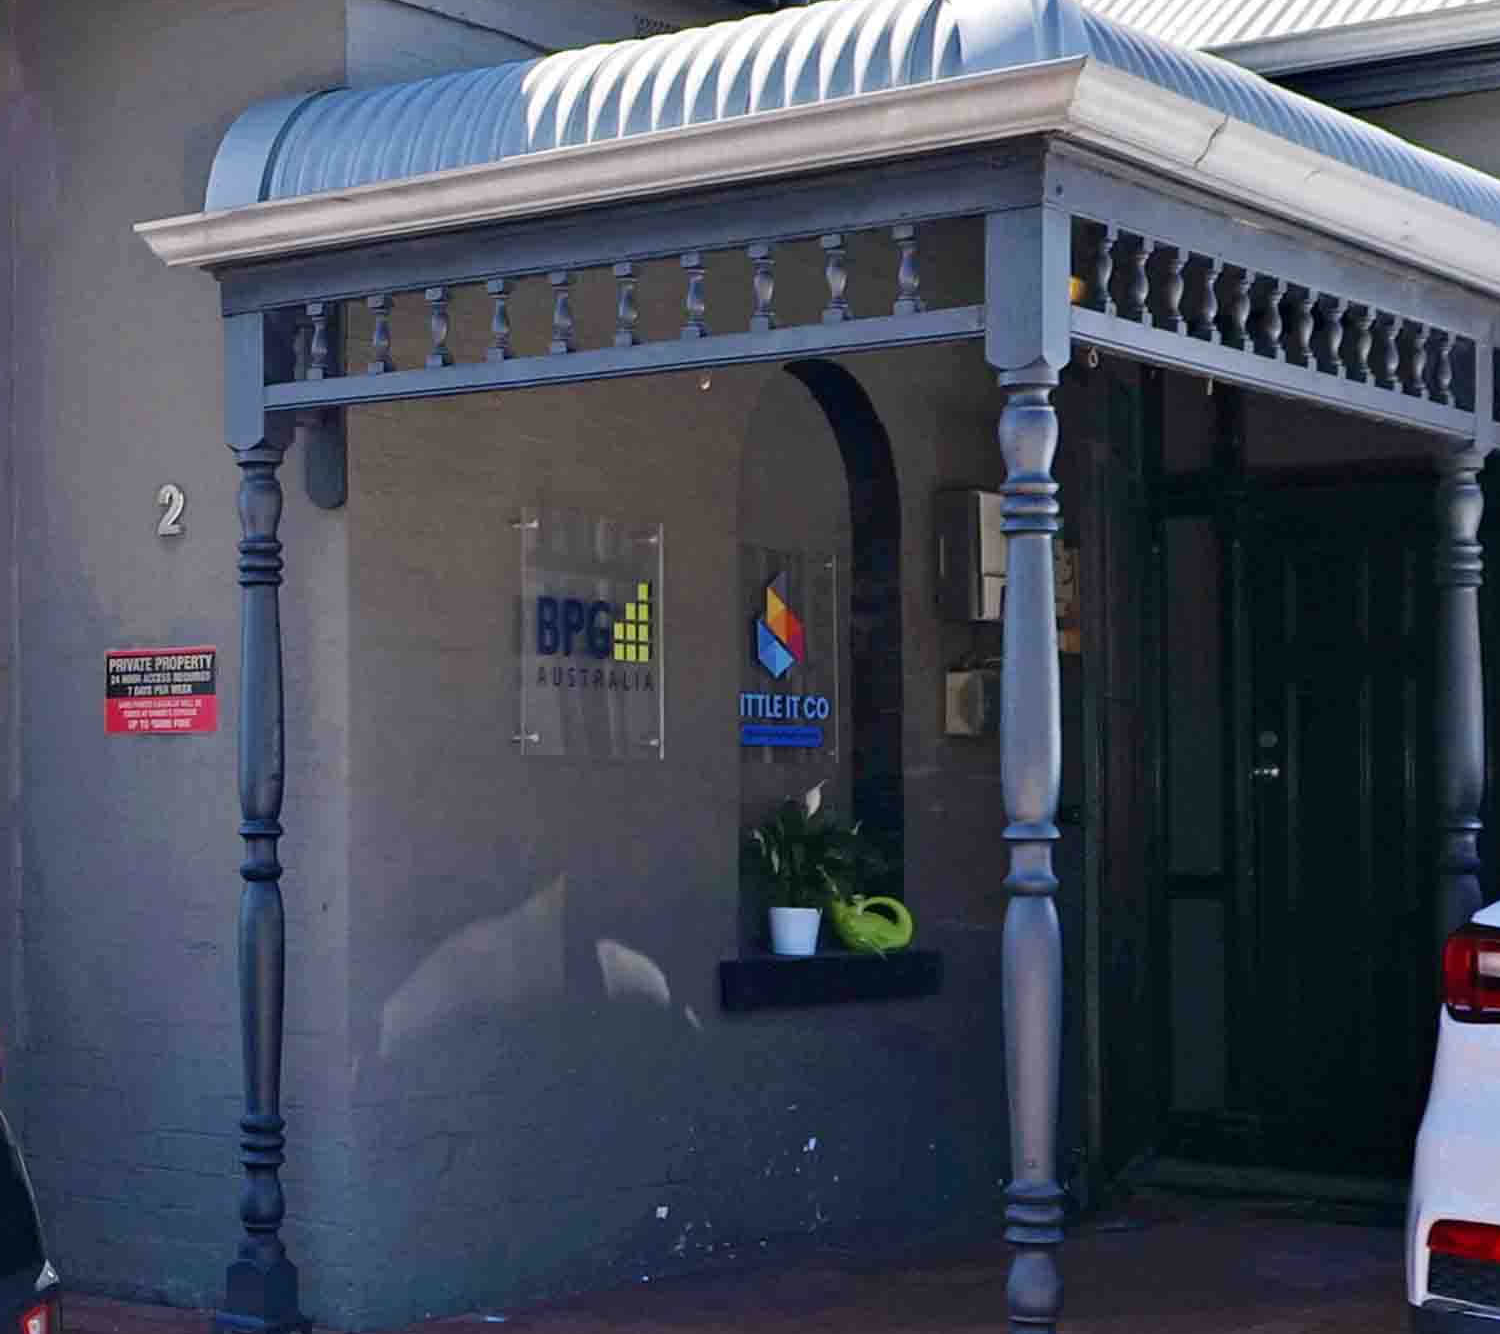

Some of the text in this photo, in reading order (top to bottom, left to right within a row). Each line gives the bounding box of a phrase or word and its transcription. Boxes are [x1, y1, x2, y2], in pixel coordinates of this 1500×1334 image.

[158, 484, 184, 535] 2
[536, 595, 612, 659] BPG
[109, 654, 213, 672] PRIVATE PROPERTY
[143, 672, 171, 683] ACCESS
[536, 667, 655, 692] AUSTRALIA
[785, 694, 801, 719] IT
[803, 696, 830, 720] CO
